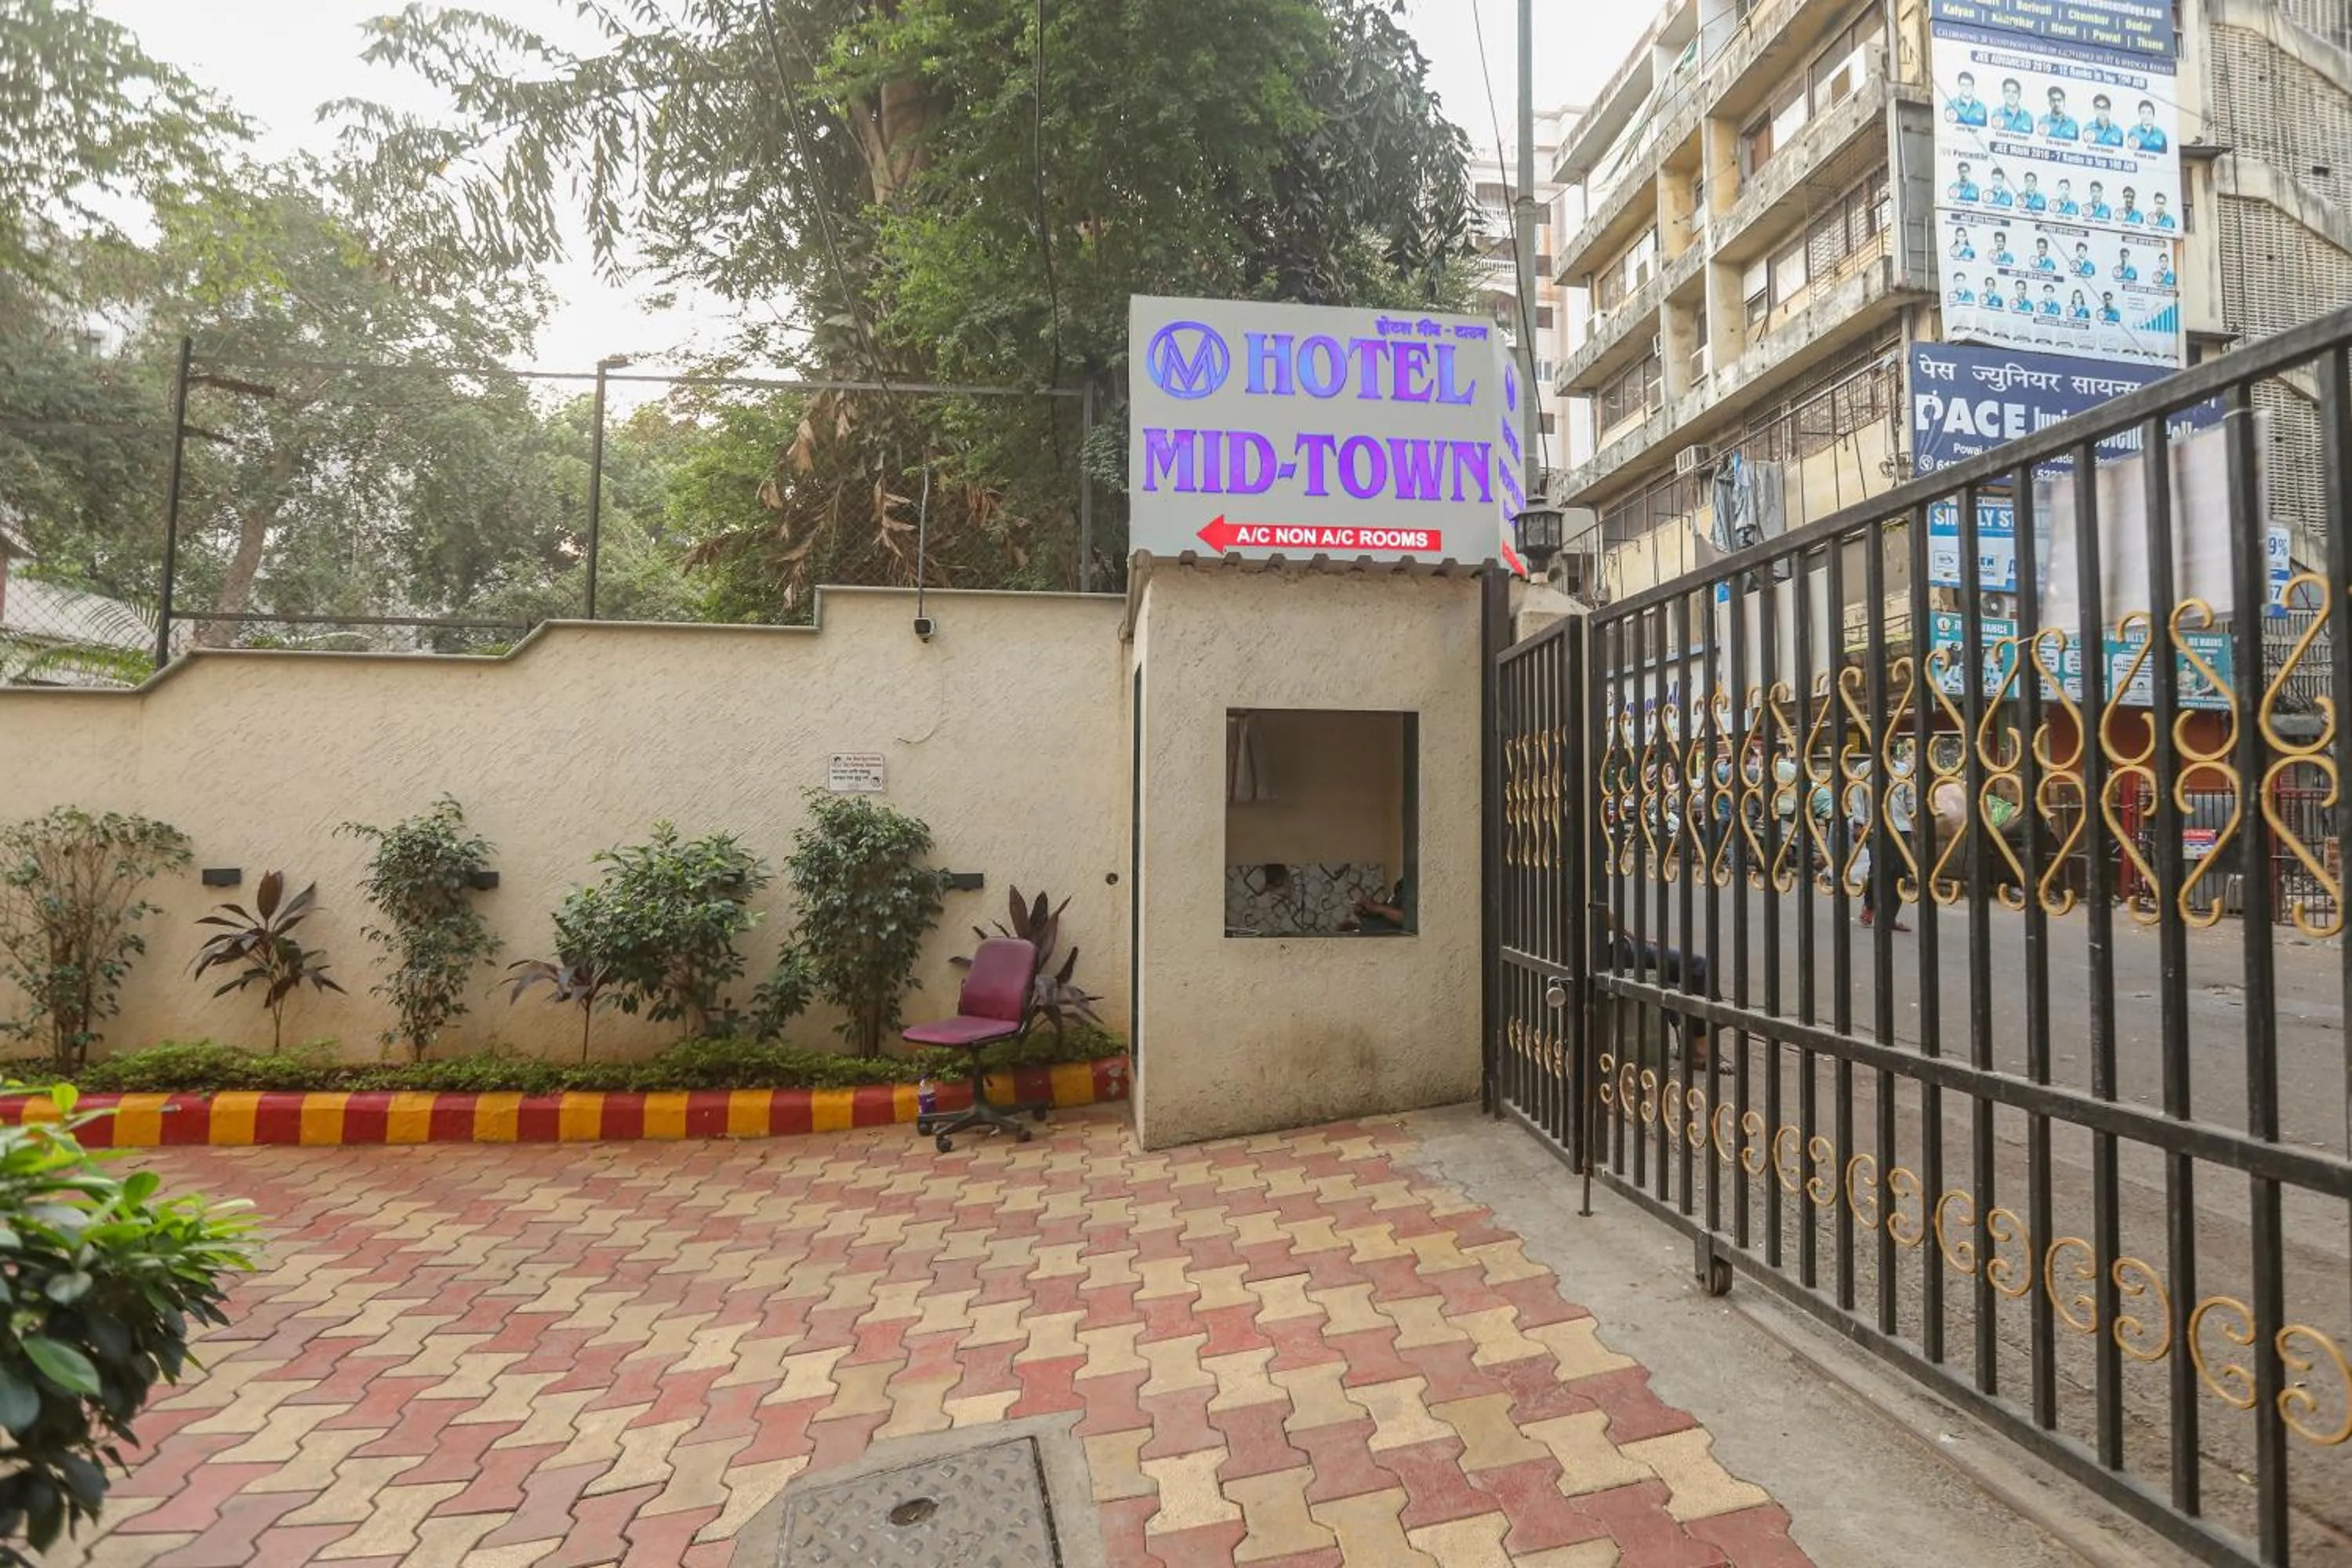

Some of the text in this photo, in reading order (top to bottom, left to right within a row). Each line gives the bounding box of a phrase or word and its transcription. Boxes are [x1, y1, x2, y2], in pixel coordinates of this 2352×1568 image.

[1244, 332, 1476, 406] HOTEL
[1918, 354, 1958, 381] पेस
[1972, 362, 2063, 392] ज्युनियर
[1915, 391, 2027, 439] PACE
[1142, 427, 1494, 503] MID-TOWN
[1236, 527, 1428, 547] A/C NON A/C ROOMS
